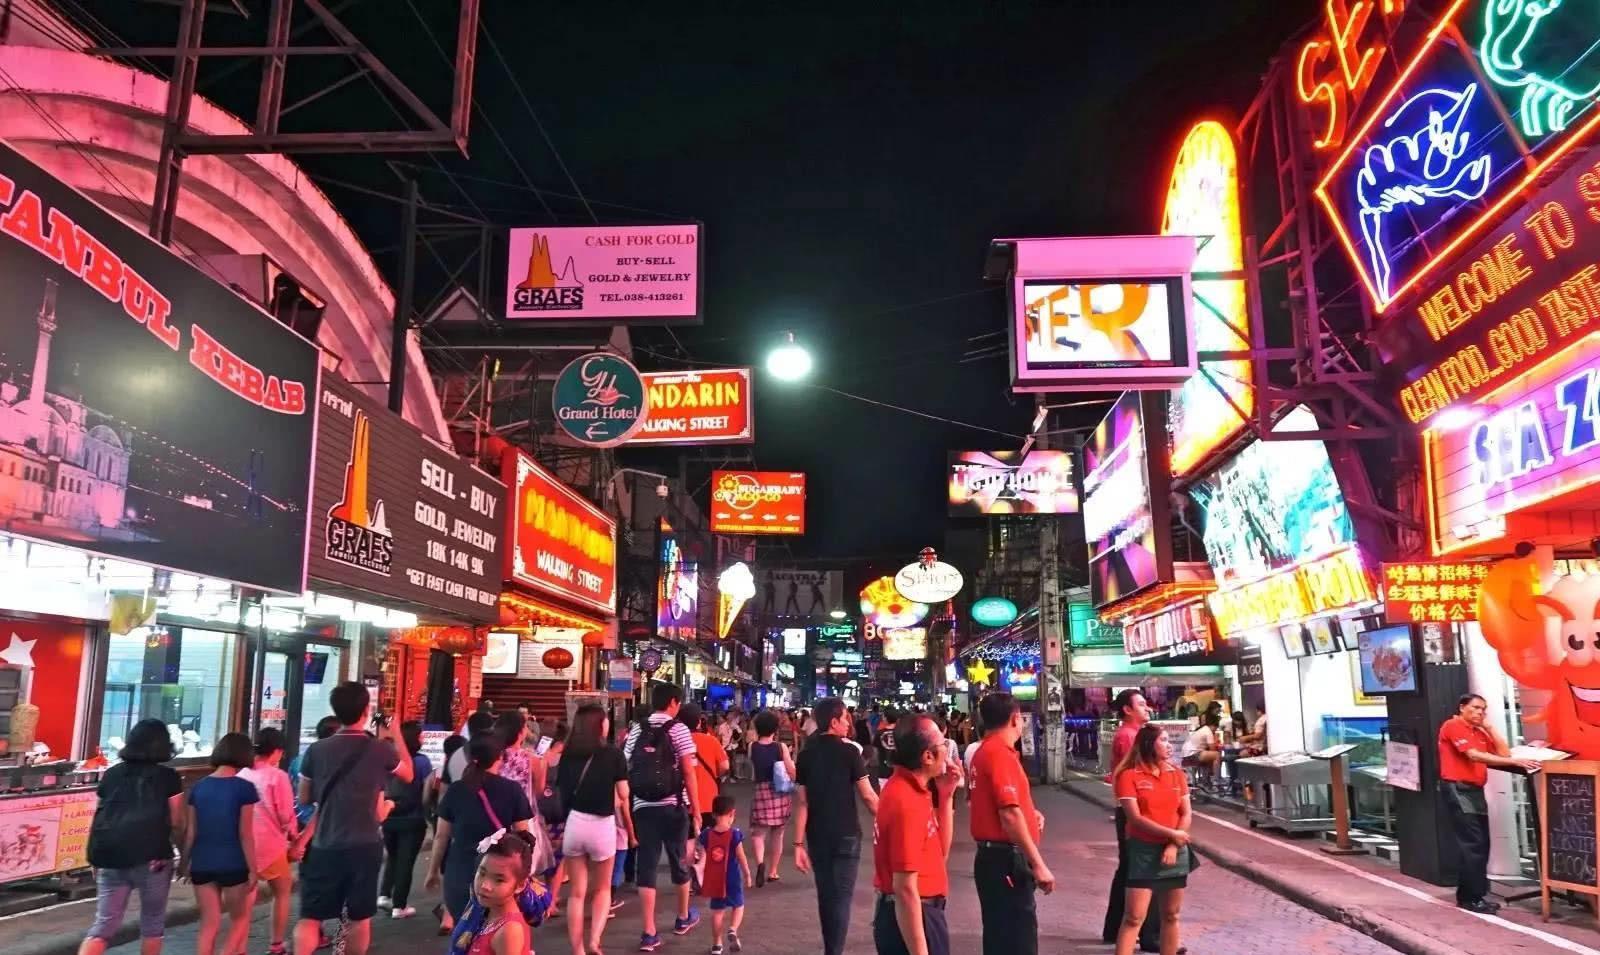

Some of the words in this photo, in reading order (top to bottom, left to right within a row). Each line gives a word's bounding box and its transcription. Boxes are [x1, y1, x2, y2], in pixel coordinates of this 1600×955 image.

[585, 235, 620, 246] CASH
[626, 234, 653, 246] FOR
[656, 233, 695, 245] GOLD
[1418, 232, 1533, 341] WELCOME
[1524, 201, 1575, 259] TO
[1578, 162, 1600, 223] S
[588, 273, 620, 283] GOLD
[623, 274, 632, 282] &
[634, 273, 691, 282] JEWELRY
[513, 287, 585, 306] GRAFS
[189, 322, 306, 416] KEBAB
[559, 406, 599, 420] Grand
[601, 406, 640, 420] Hotel
[648, 381, 740, 410] NDARIN
[1400, 368, 1452, 424] CLEAN
[1556, 367, 1600, 456] Z
[641, 417, 687, 432] ALKING
[690, 415, 730, 431] STREET
[420, 458, 456, 500] SELL
[470, 485, 497, 519] BUY
[328, 518, 394, 566] GRAFS
[415, 501, 449, 536] GOLD,
[451, 518, 497, 553] JEWELRY
[330, 547, 357, 563] Jewelry
[360, 556, 390, 573] Exchange
[426, 540, 447, 563] 18K
[450, 549, 469, 571] 14K
[471, 556, 485, 576] 9K
[536, 549, 574, 584] WALKING
[577, 568, 604, 593] STREET
[426, 574, 446, 593] FAST
[445, 579, 464, 599] CASH
[465, 586, 478, 602] FOR
